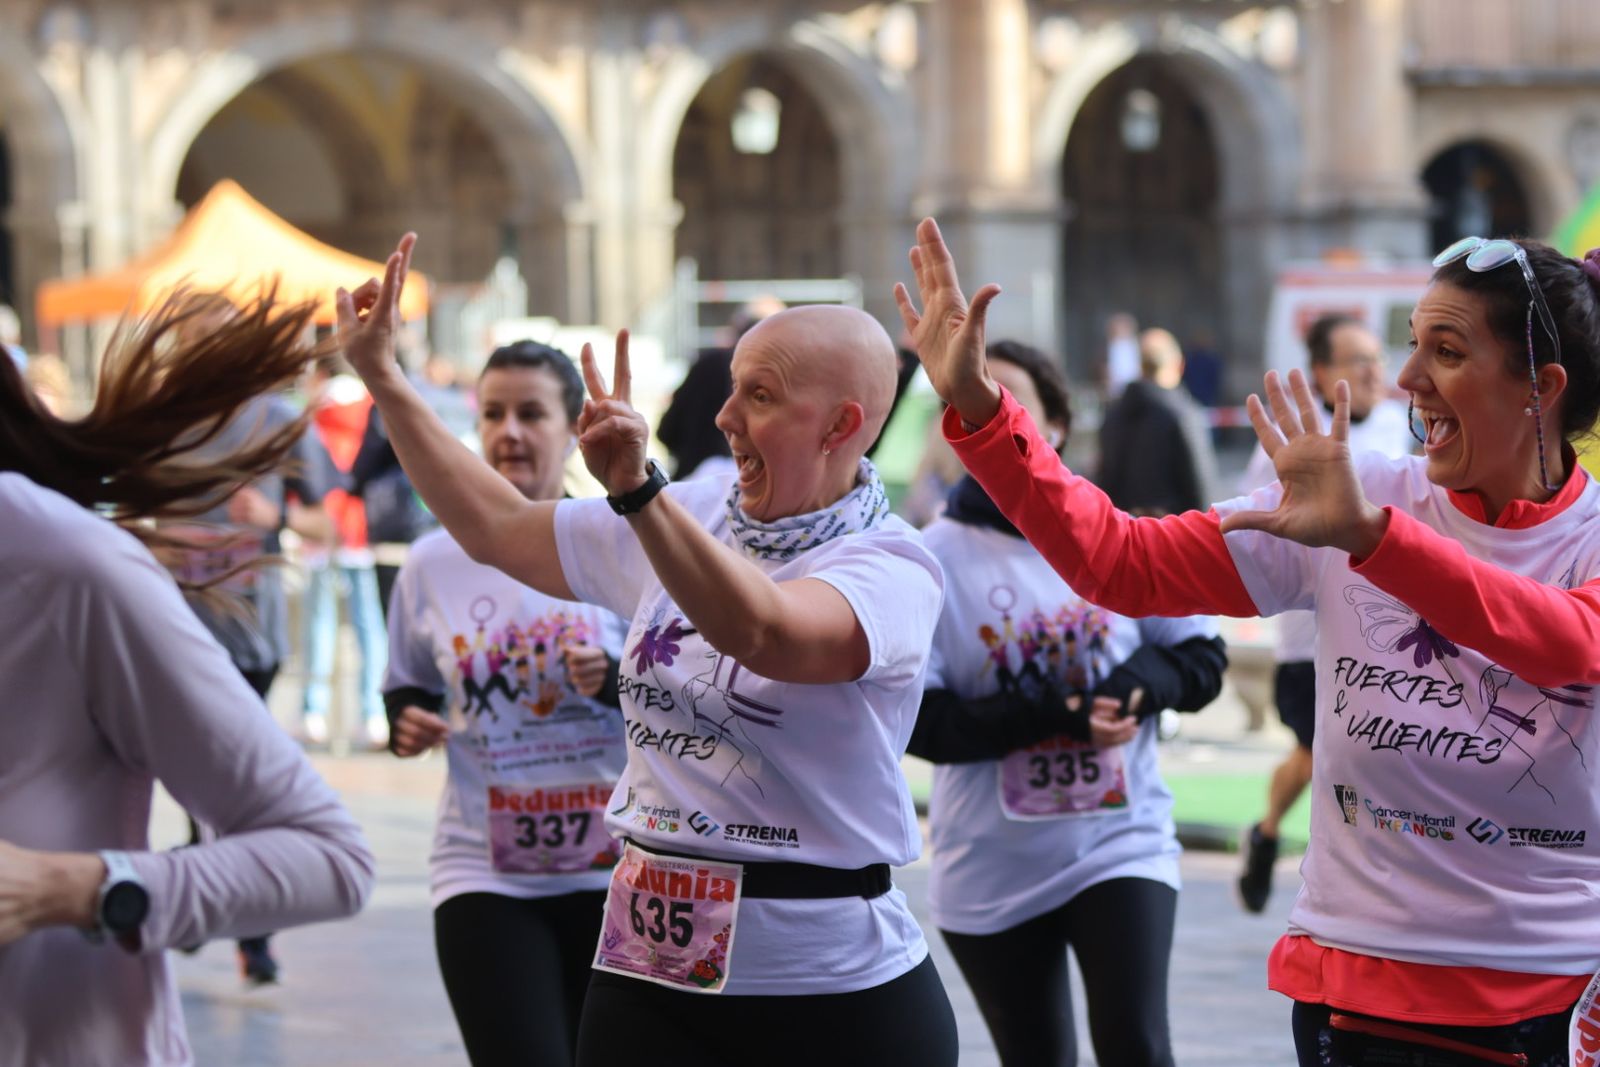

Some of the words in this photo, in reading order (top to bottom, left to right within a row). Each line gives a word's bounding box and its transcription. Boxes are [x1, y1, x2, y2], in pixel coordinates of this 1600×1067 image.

[1334, 657, 1464, 707] FUERTES
[1334, 690, 1348, 718] &
[1347, 710, 1502, 764] VALIENTES
[1028, 751, 1100, 789] 335
[515, 812, 591, 848] 337
[724, 824, 799, 842] STRENIA
[1413, 810, 1456, 828] infantil
[1507, 827, 1586, 842] STRENIA
[630, 892, 694, 948] 635
